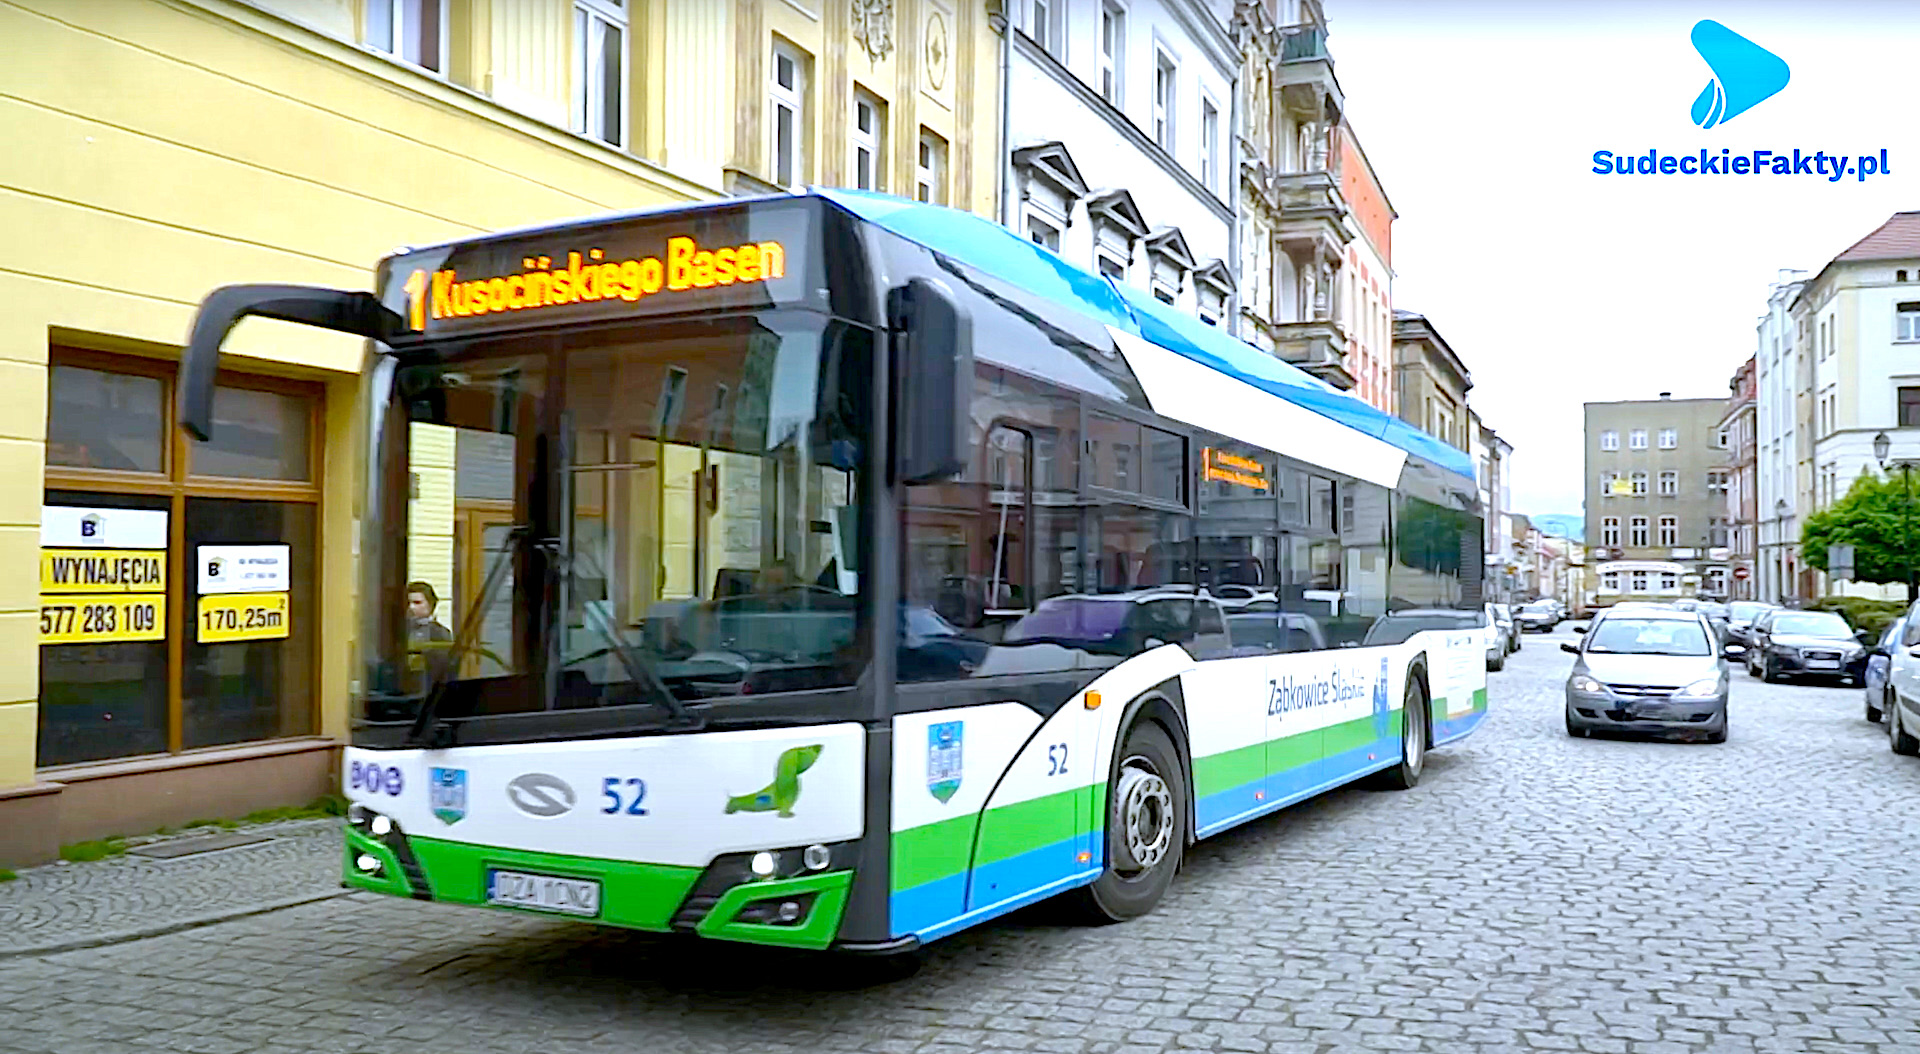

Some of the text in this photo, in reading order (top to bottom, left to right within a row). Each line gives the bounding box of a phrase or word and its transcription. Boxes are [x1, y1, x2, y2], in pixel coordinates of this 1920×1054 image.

[402, 235, 785, 332] 1 Kusocińskiego Basen
[53, 555, 160, 591] WYNAJĘCIA
[40, 604, 155, 635] 577 283 109
[1267, 674, 1329, 723] Ząbkowice
[1047, 742, 1069, 777] 52
[600, 776, 649, 817] 52
